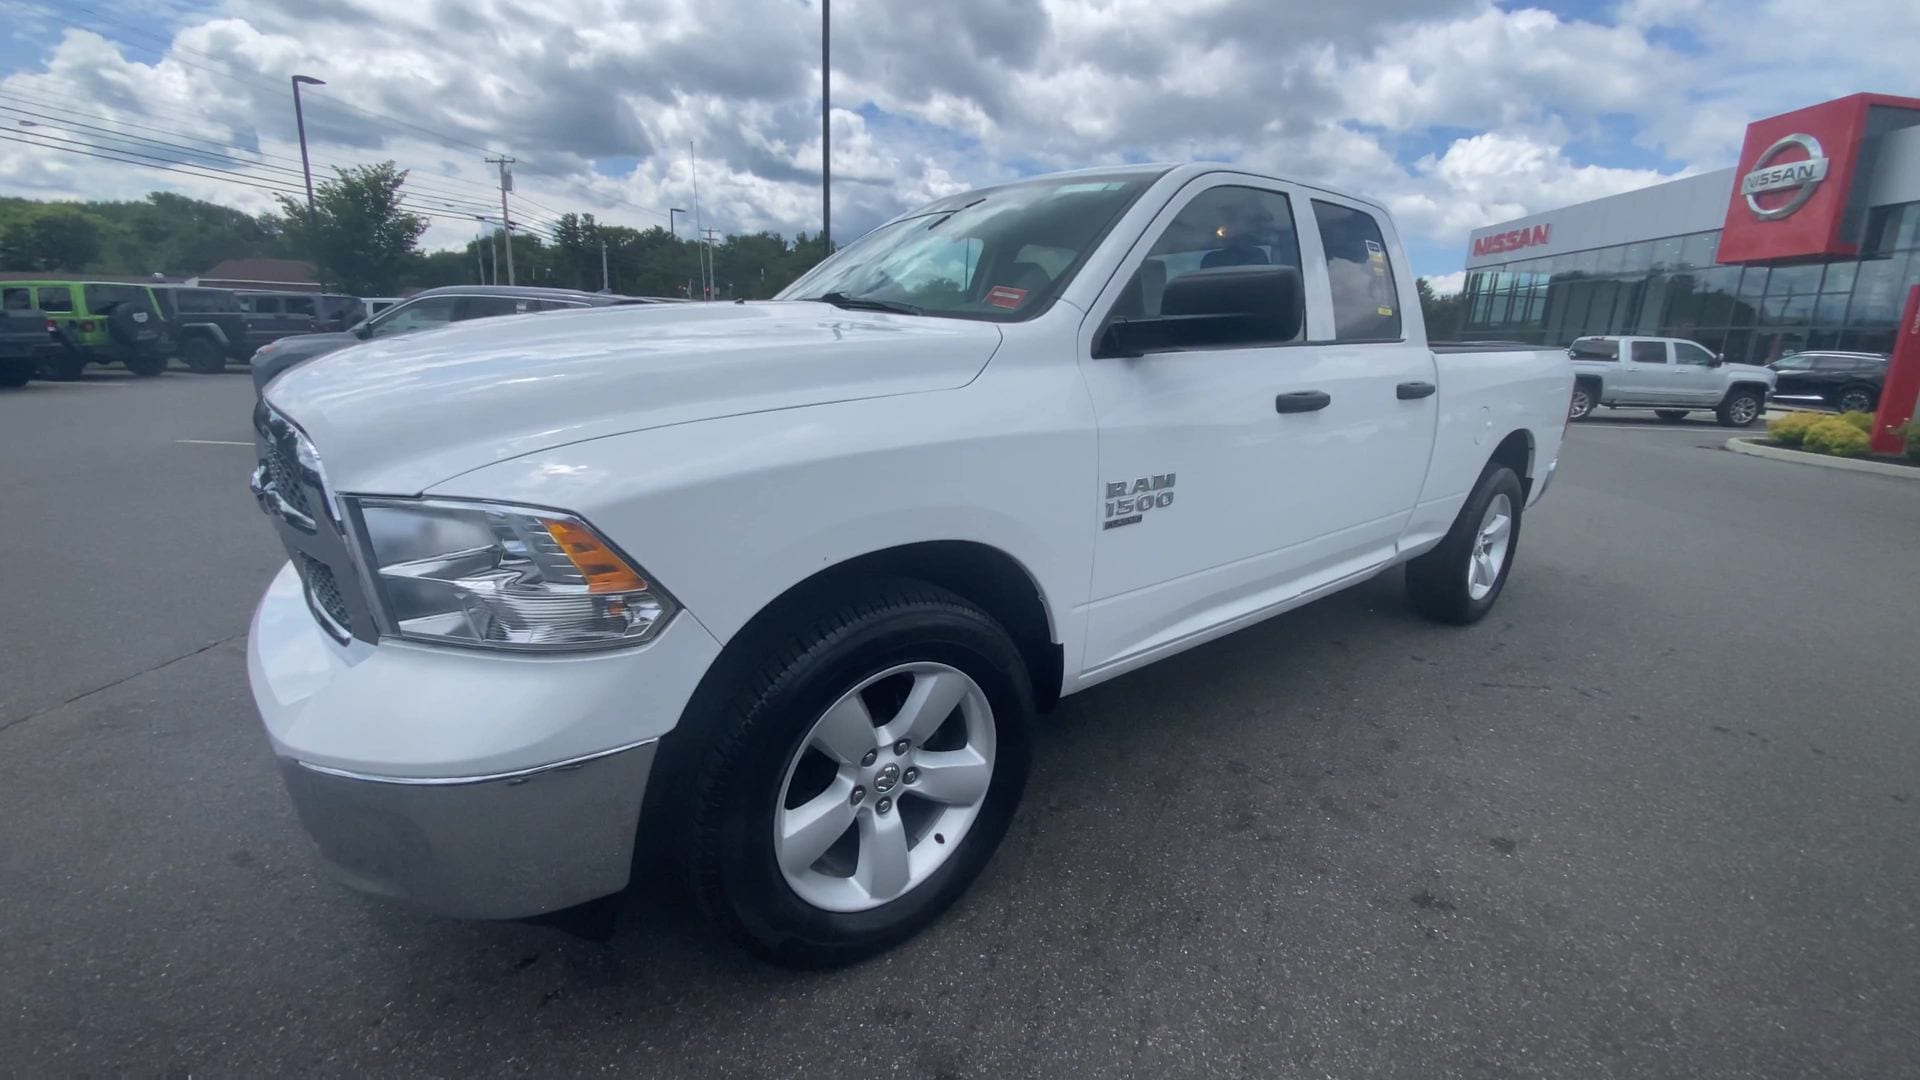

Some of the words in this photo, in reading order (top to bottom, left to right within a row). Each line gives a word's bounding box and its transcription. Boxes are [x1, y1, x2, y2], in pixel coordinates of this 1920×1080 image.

[1748, 164, 1815, 188] NISSAN
[1473, 223, 1551, 257] NISSAN
[1105, 472, 1176, 499] RAM
[1105, 491, 1175, 518] 1500
